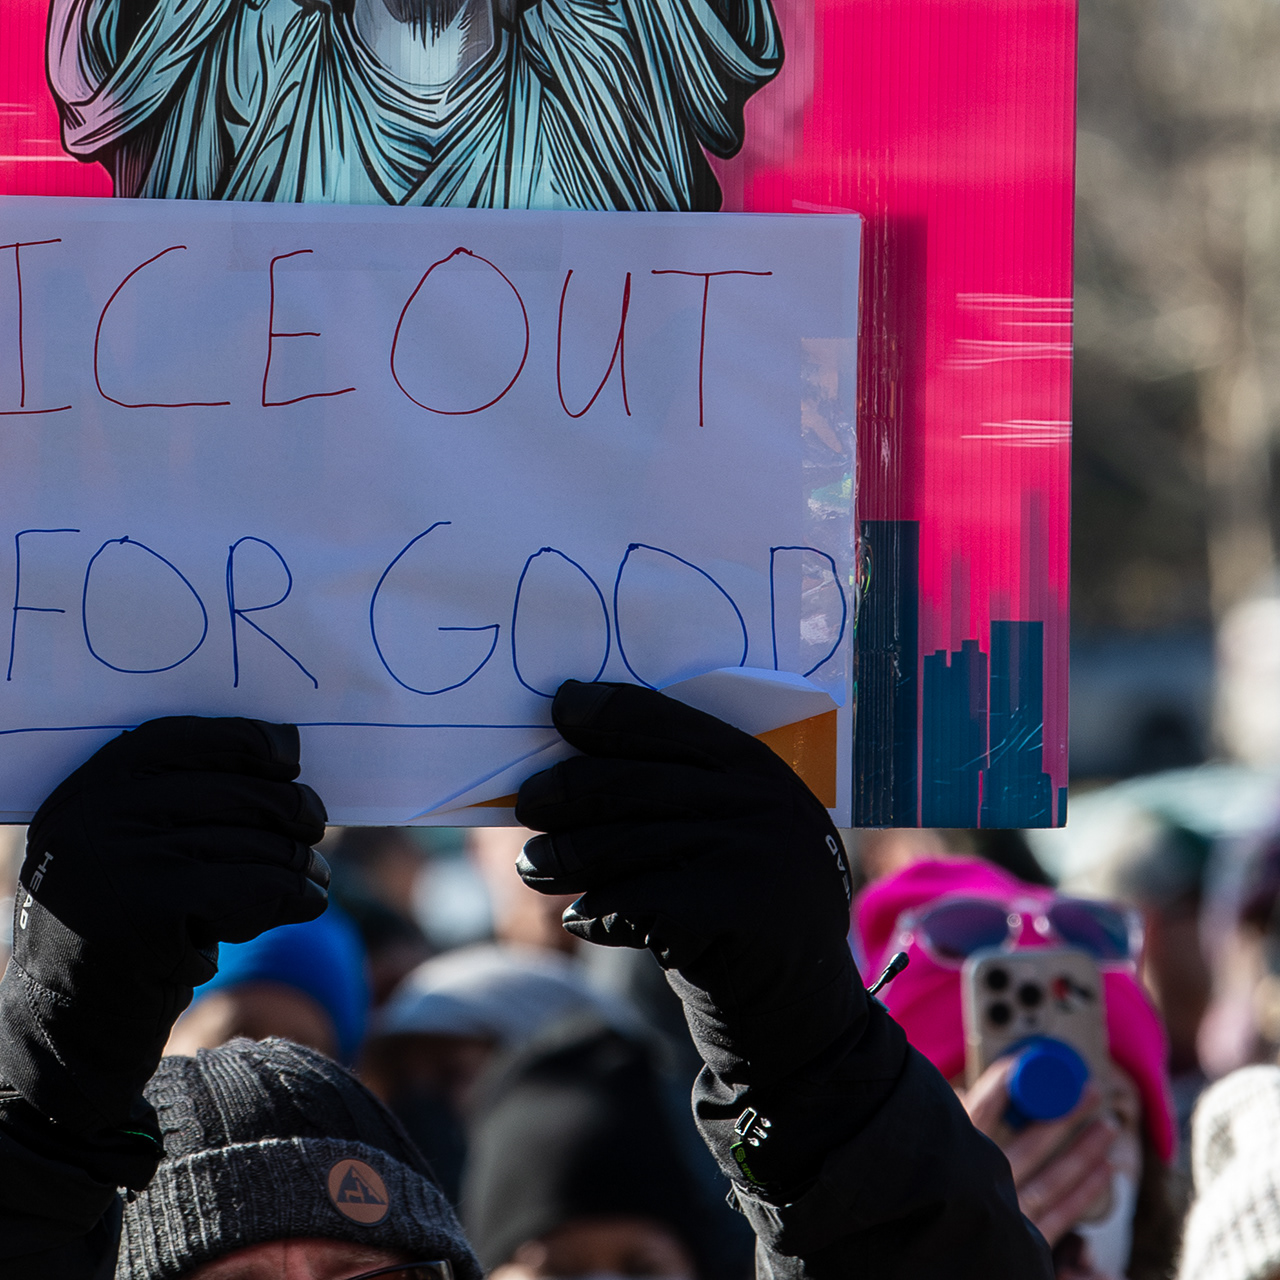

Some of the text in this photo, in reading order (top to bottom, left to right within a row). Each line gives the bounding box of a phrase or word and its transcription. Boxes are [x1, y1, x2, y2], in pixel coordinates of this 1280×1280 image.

[6, 521, 848, 699] FOR GOOD
[20, 851, 54, 930] HEAD
